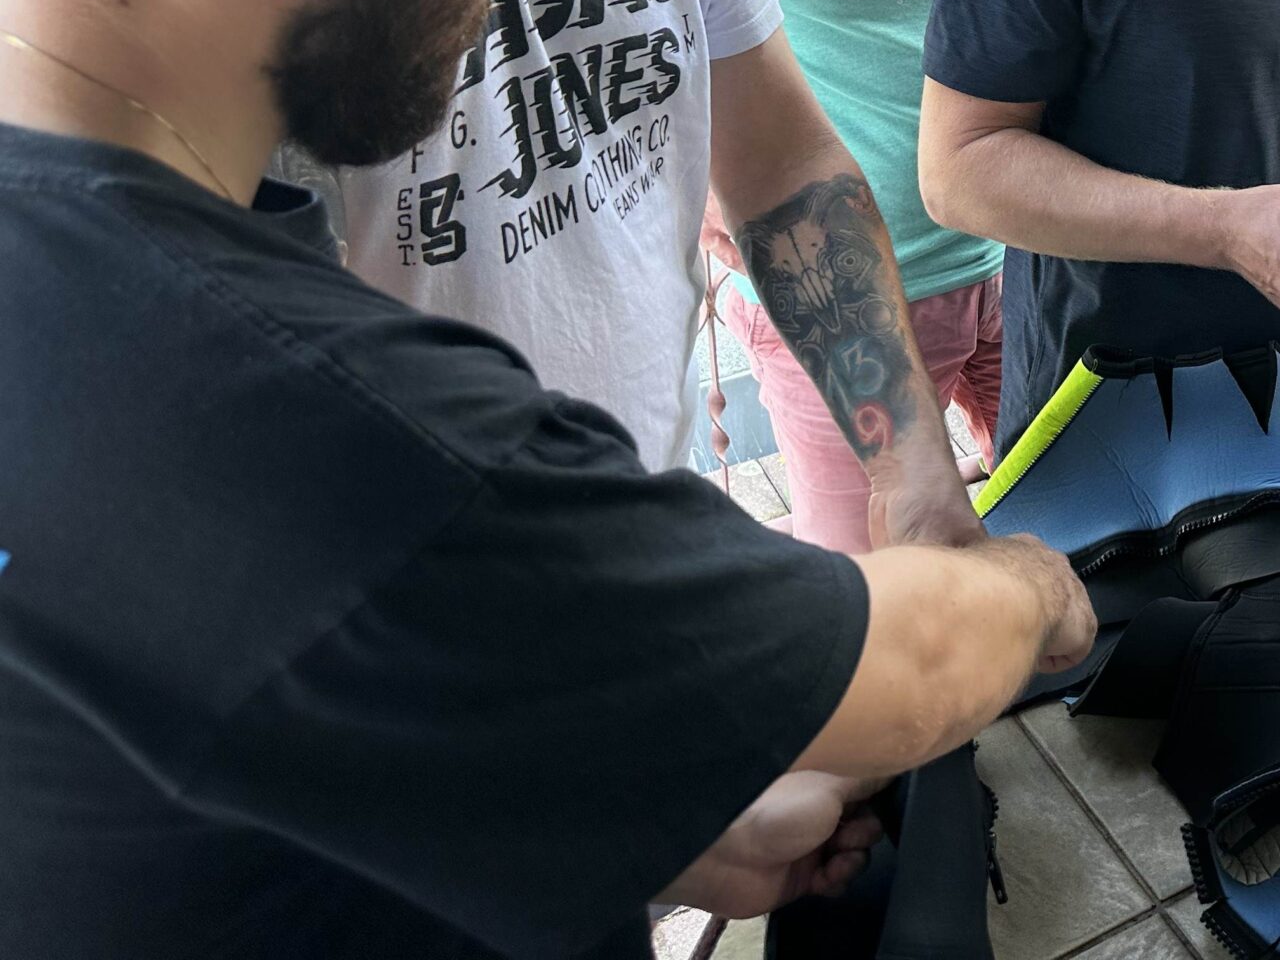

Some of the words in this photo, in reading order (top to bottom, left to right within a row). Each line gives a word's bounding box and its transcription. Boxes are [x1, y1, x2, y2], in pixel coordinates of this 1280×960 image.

[477, 26, 681, 199] JONES
[501, 184, 579, 265] DENIM
[648, 113, 671, 152] CO.
